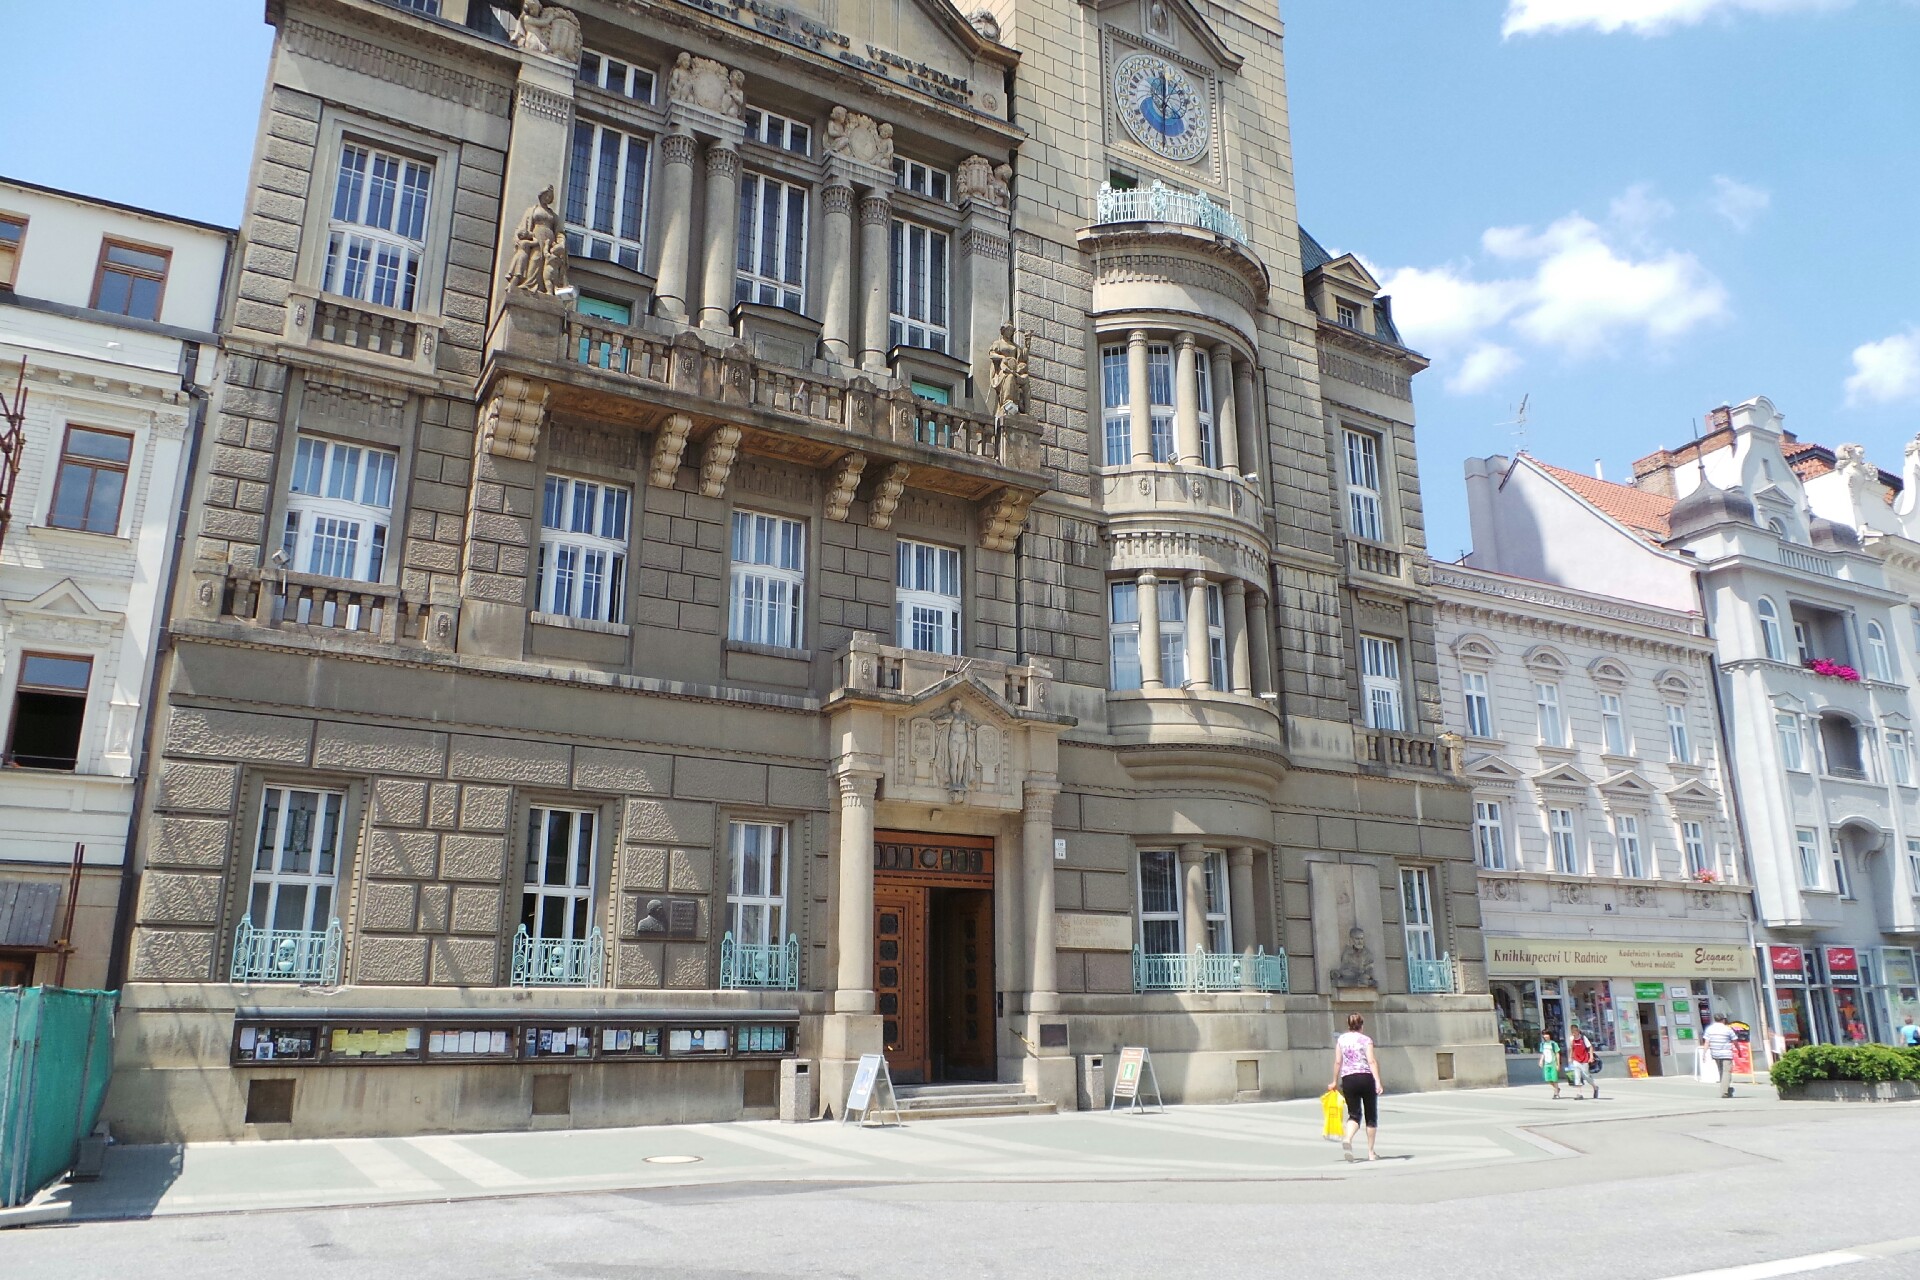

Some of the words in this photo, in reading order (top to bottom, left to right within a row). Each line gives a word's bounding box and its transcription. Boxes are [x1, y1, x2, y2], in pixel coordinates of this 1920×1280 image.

[1493, 949, 1560, 966] Knihkupectví
[1564, 951, 1572, 963] U
[1574, 951, 1608, 964] Radnice
[1694, 947, 1735, 964] Elegance
